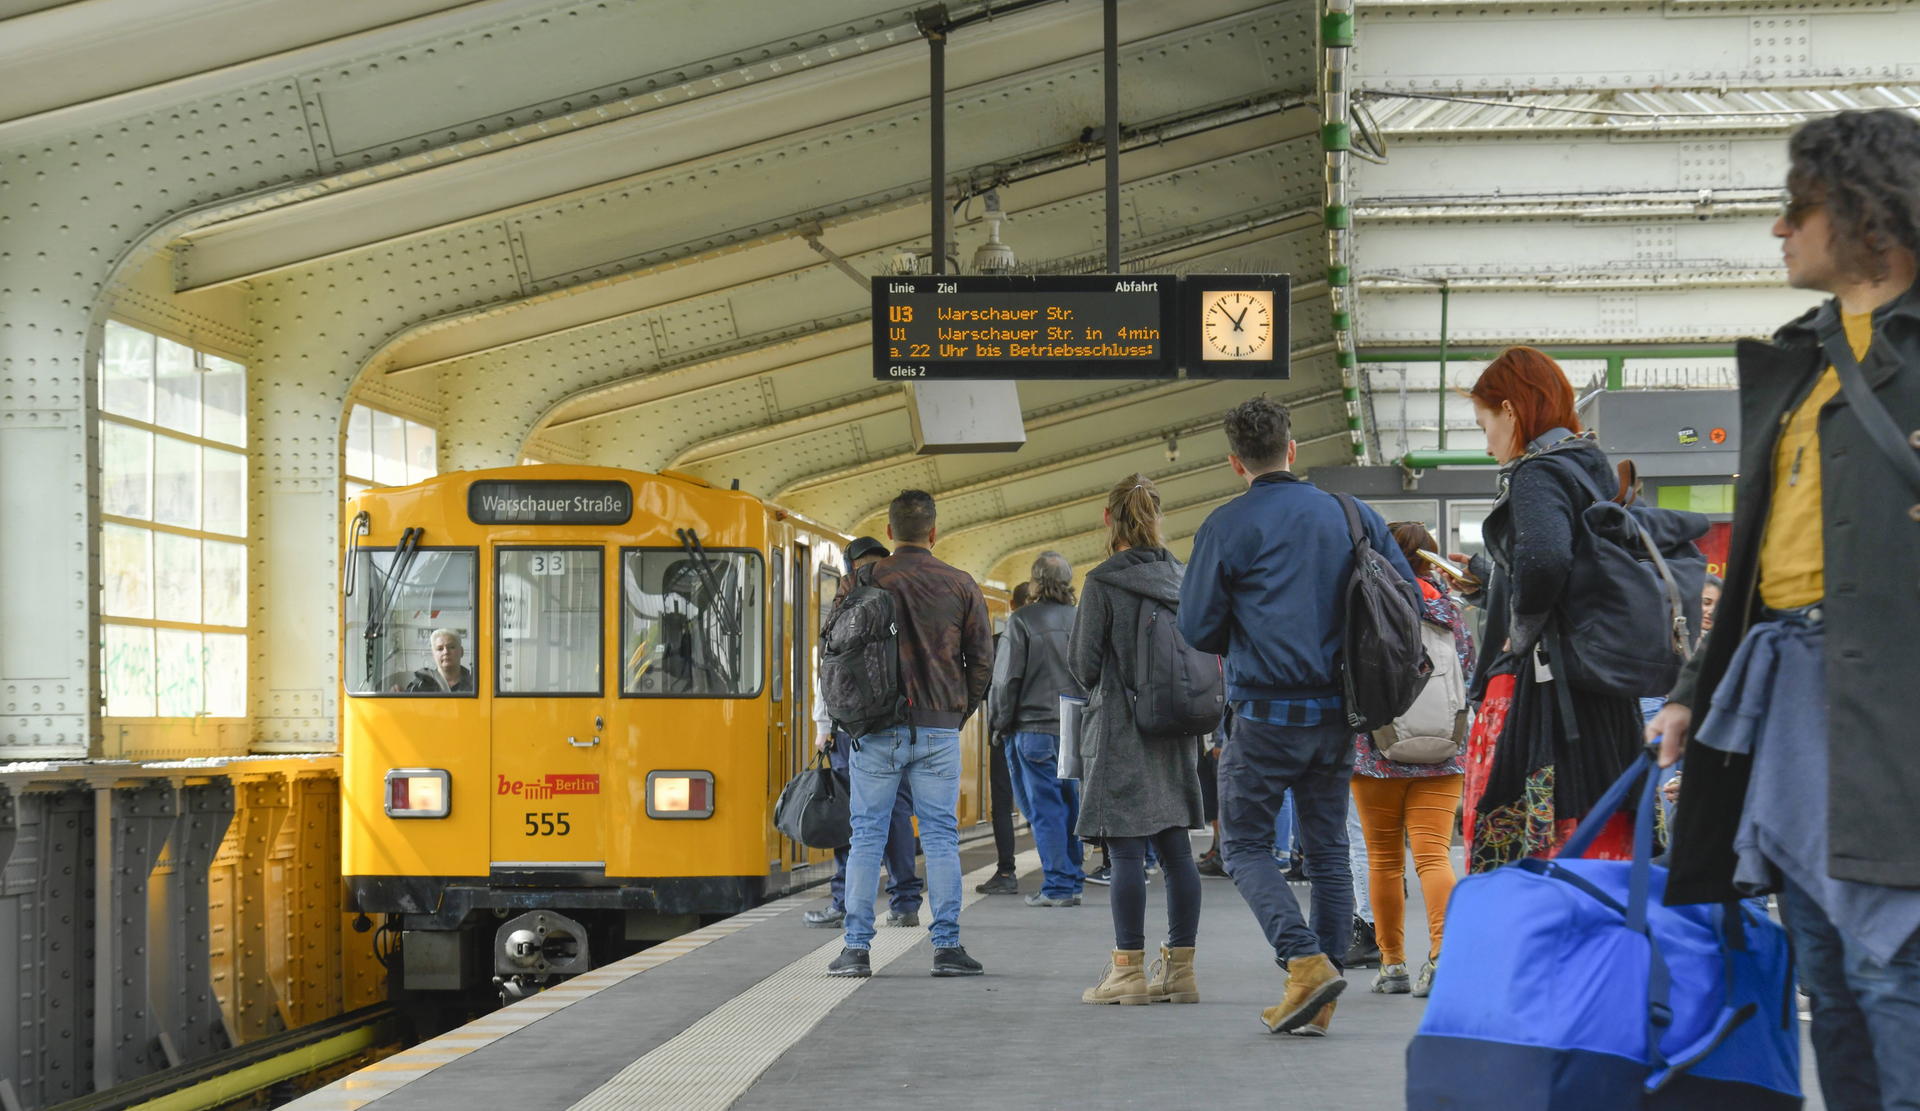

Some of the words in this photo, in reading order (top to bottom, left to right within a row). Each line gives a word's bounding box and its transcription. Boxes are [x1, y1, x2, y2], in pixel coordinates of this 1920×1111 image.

[889, 282, 915, 294] Linie
[937, 282, 957, 294] Ziel
[1115, 281, 1158, 292] Abfahrt
[889, 305, 913, 323] U3
[938, 306, 1039, 320] Warschauer
[1046, 306, 1075, 320] Str.
[889, 327, 907, 341] U1
[938, 326, 1039, 341] Warschauer
[1046, 326, 1075, 340] Str.
[1085, 326, 1103, 340] in
[889, 347, 902, 358] a.
[910, 344, 931, 357] 22
[939, 343, 969, 357] Uhr
[975, 343, 1002, 357] bis
[889, 365, 917, 377] Gleis
[919, 365, 926, 377] 2
[482, 495, 571, 512] Warschauer
[573, 495, 622, 512] Straße
[497, 774, 524, 796] be
[555, 779, 595, 792] Berlin
[525, 812, 571, 837] 555
